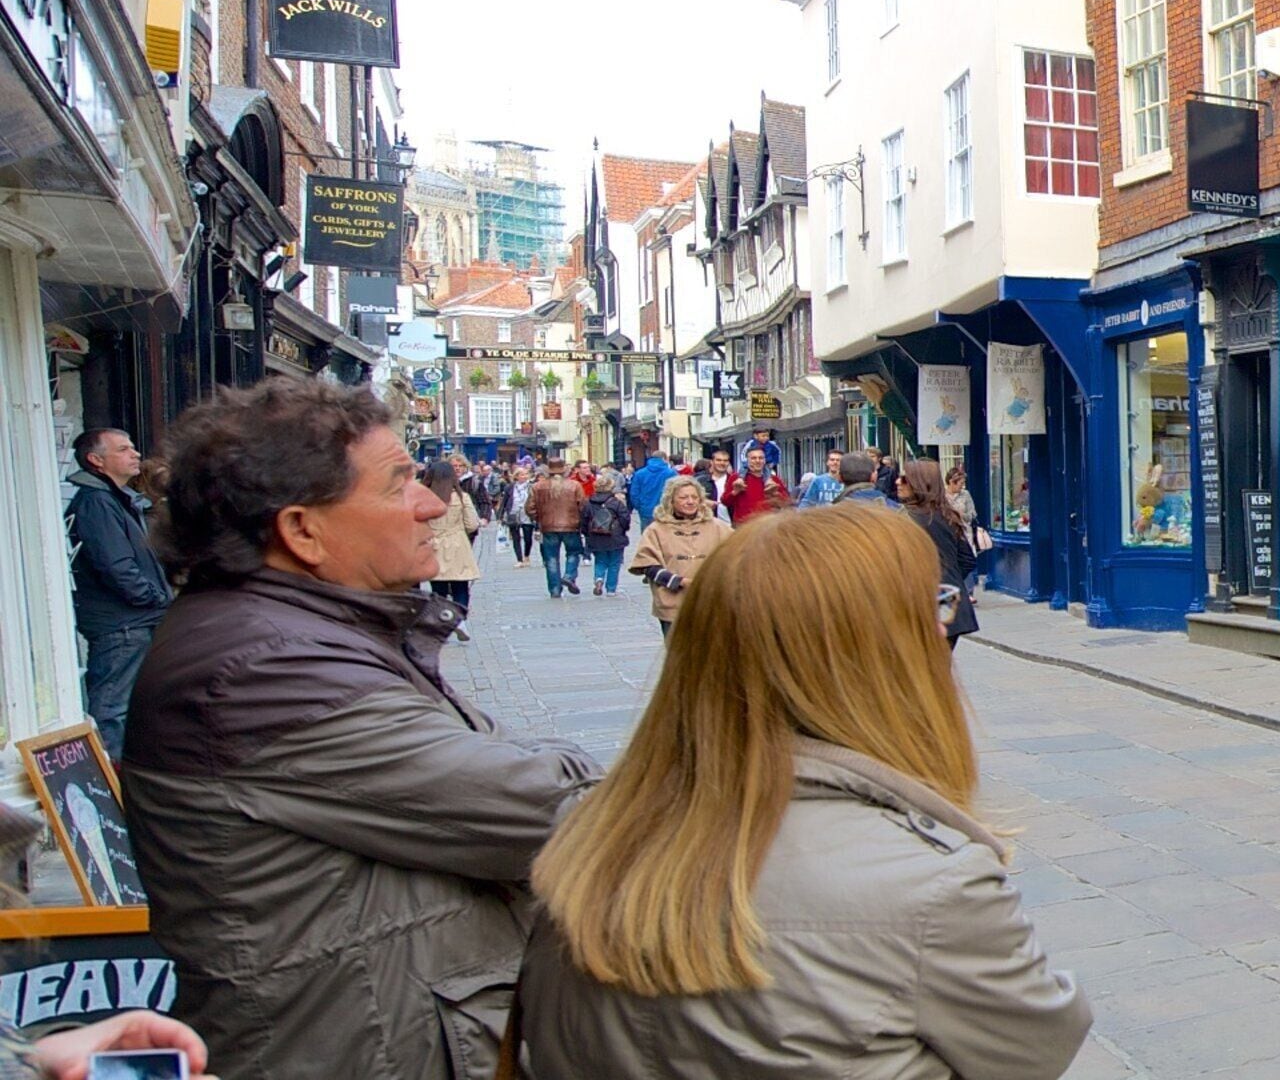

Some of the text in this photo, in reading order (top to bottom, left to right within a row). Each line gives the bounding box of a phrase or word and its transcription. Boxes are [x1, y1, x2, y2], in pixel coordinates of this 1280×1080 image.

[314, 185, 397, 204] SAFFRONS
[1191, 189, 1257, 207] KENNEDY'S
[330, 202, 379, 214] OF YORK
[353, 218, 385, 229] GIFTS
[387, 221, 397, 230] &
[321, 225, 388, 239] JEWELLERY
[349, 303, 396, 313] Rohan
[486, 349, 500, 357] YE
[502, 349, 530, 358] OLDE
[571, 352, 593, 360] INNE
[1251, 495, 1271, 505] KEN
